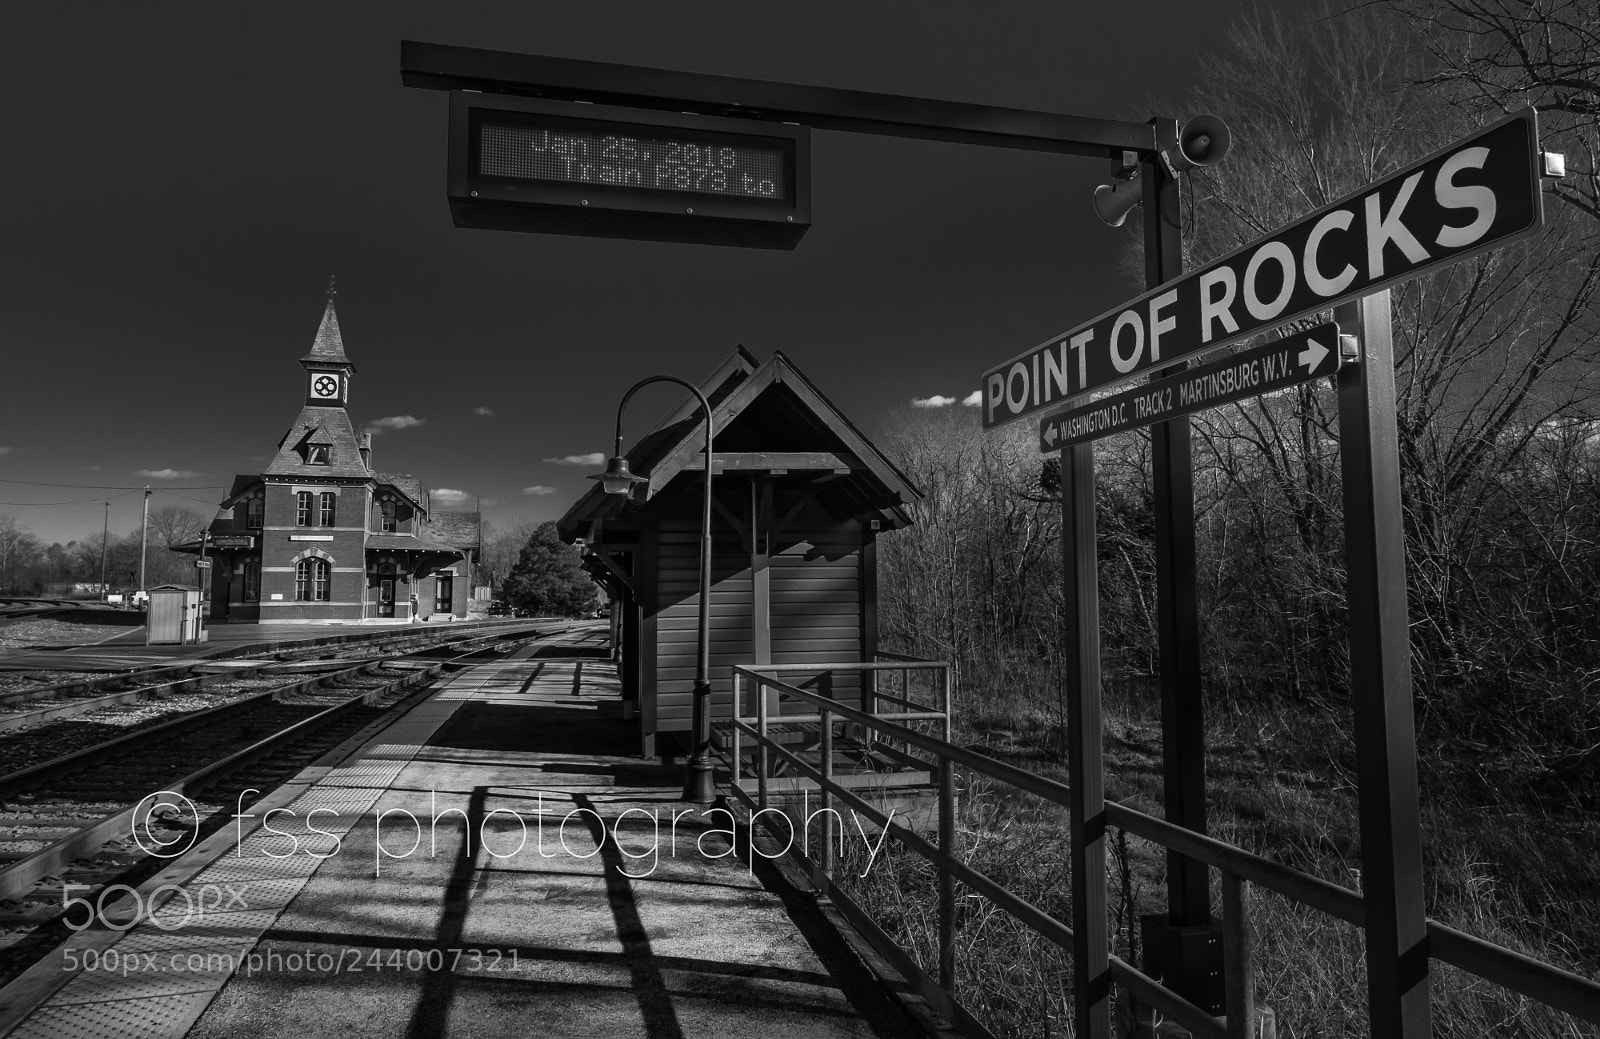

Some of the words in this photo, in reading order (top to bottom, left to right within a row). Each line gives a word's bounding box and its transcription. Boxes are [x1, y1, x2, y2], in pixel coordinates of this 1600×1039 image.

[532, 130, 587, 156] Jan
[602, 136, 650, 161] 25,
[665, 142, 735, 168] 2018
[560, 156, 640, 184] Train
[655, 164, 726, 191] P873
[741, 172, 774, 195] to
[986, 328, 1095, 423] POINT
[1110, 289, 1178, 374] OF
[1200, 147, 1497, 342] ROCKS
[1060, 408, 1111, 441] WASHINGTON
[1111, 402, 1129, 426] D.C.
[1134, 391, 1164, 419] TRACK
[1166, 387, 1173, 411] 2
[1180, 361, 1260, 405] MARTINSBURG
[1262, 350, 1293, 385] W.V.
